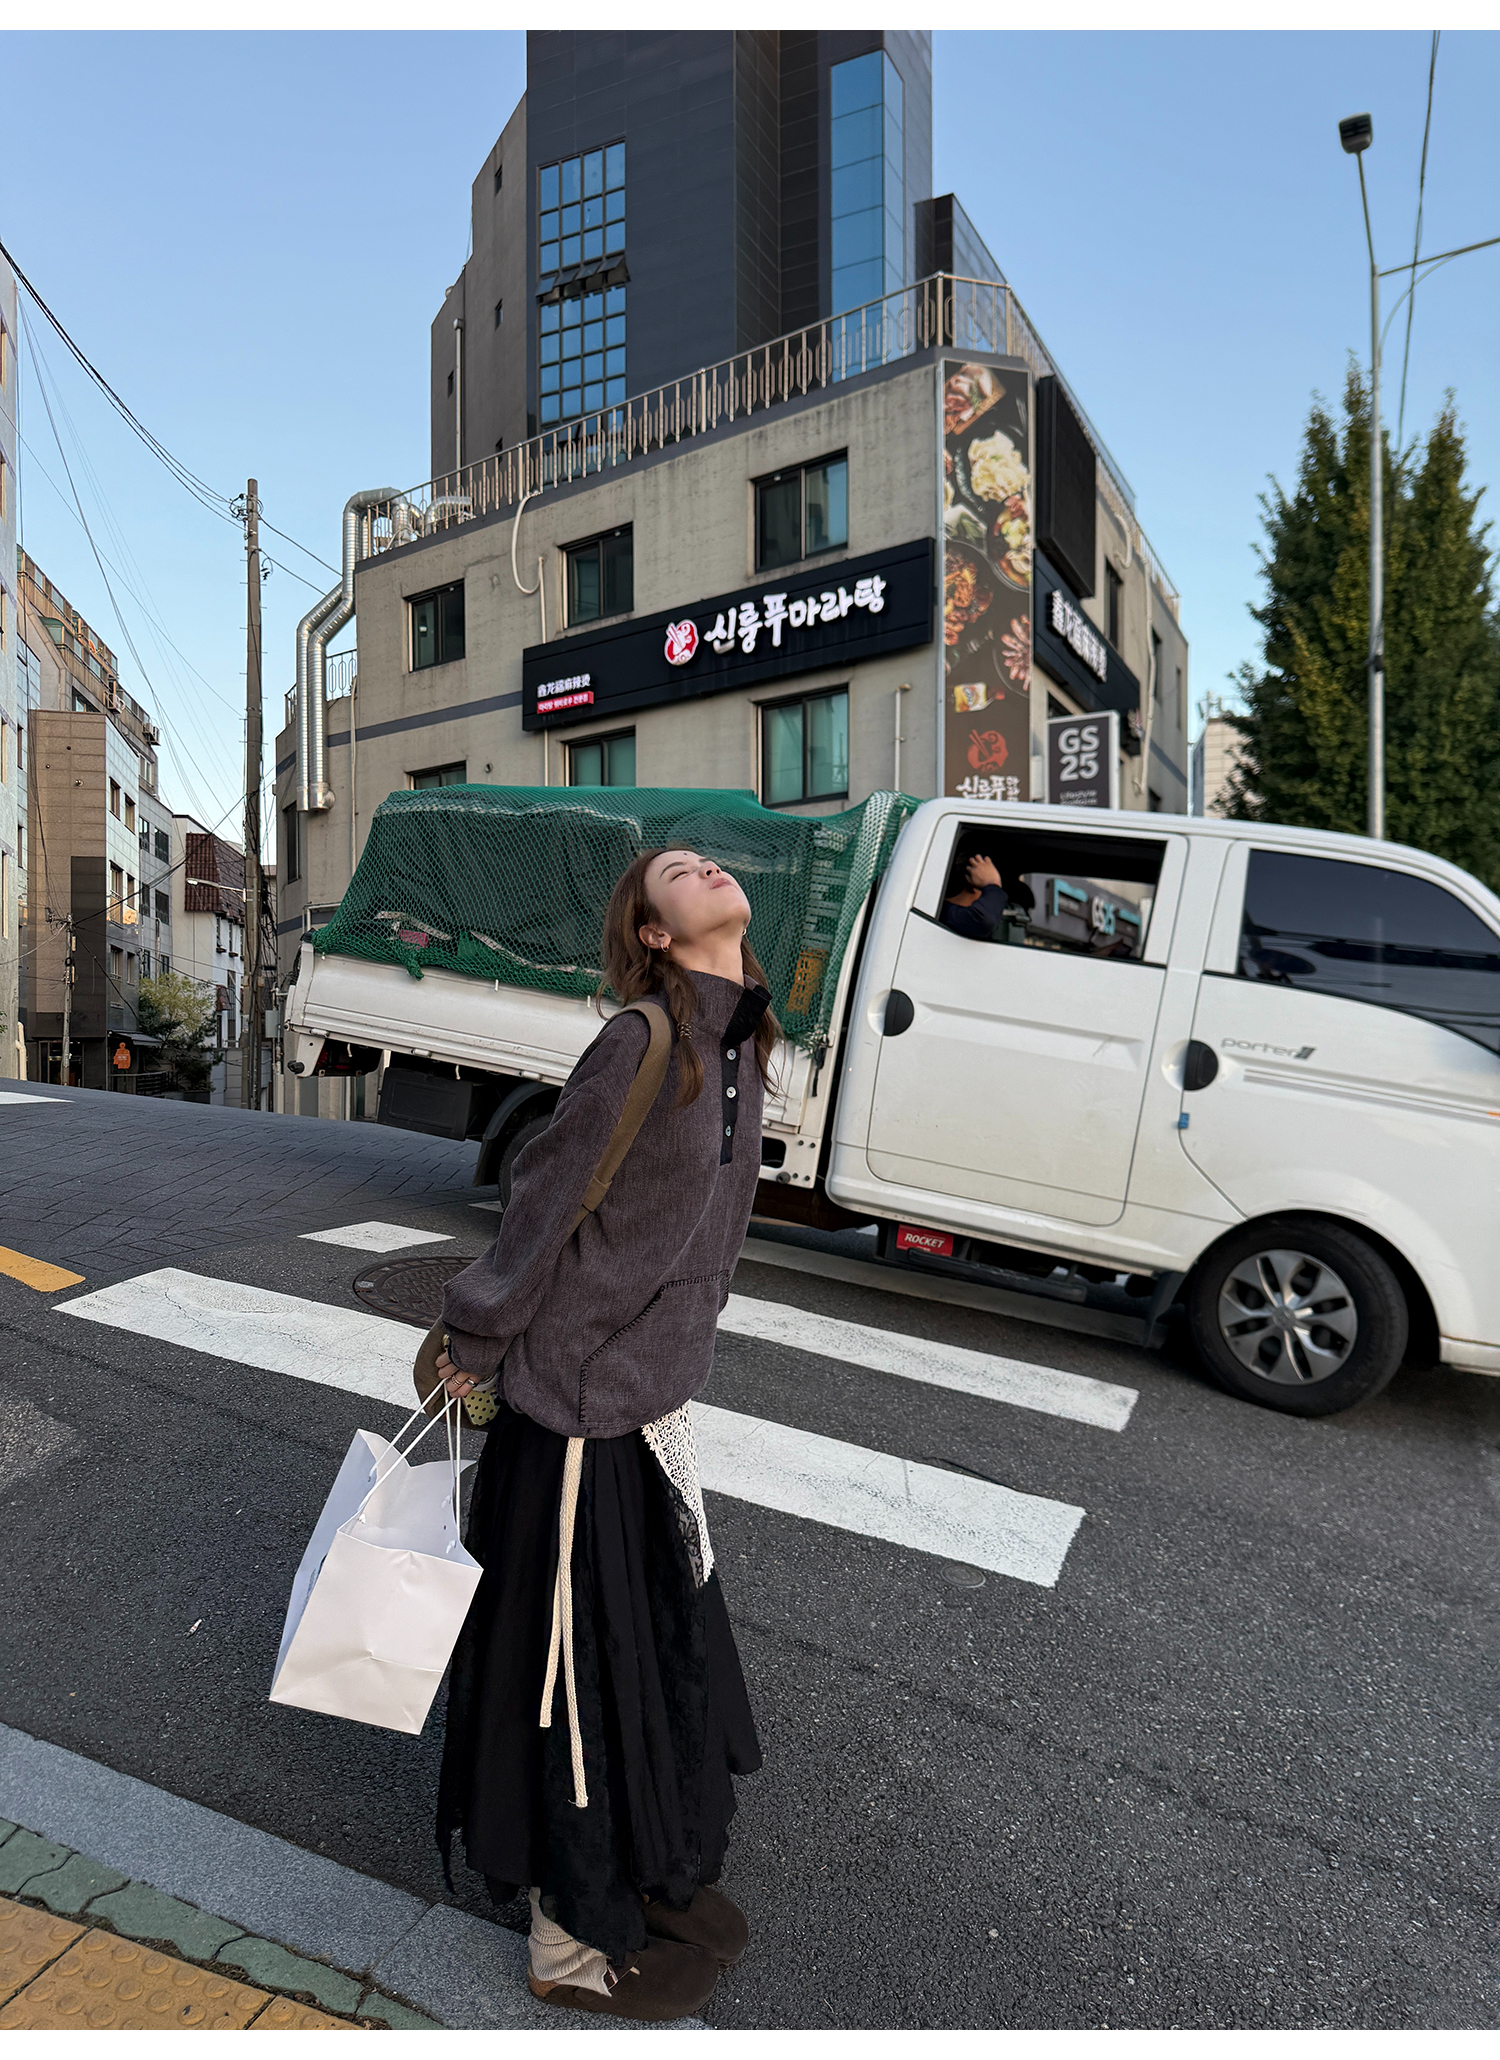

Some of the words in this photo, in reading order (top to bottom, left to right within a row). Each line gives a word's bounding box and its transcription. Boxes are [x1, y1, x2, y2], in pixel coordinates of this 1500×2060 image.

[703, 574, 887, 654] 신룽푸마라탕
[1058, 725, 1100, 755] GS
[1059, 751, 1099, 782] 25
[904, 1232, 946, 1249] ROCKET
